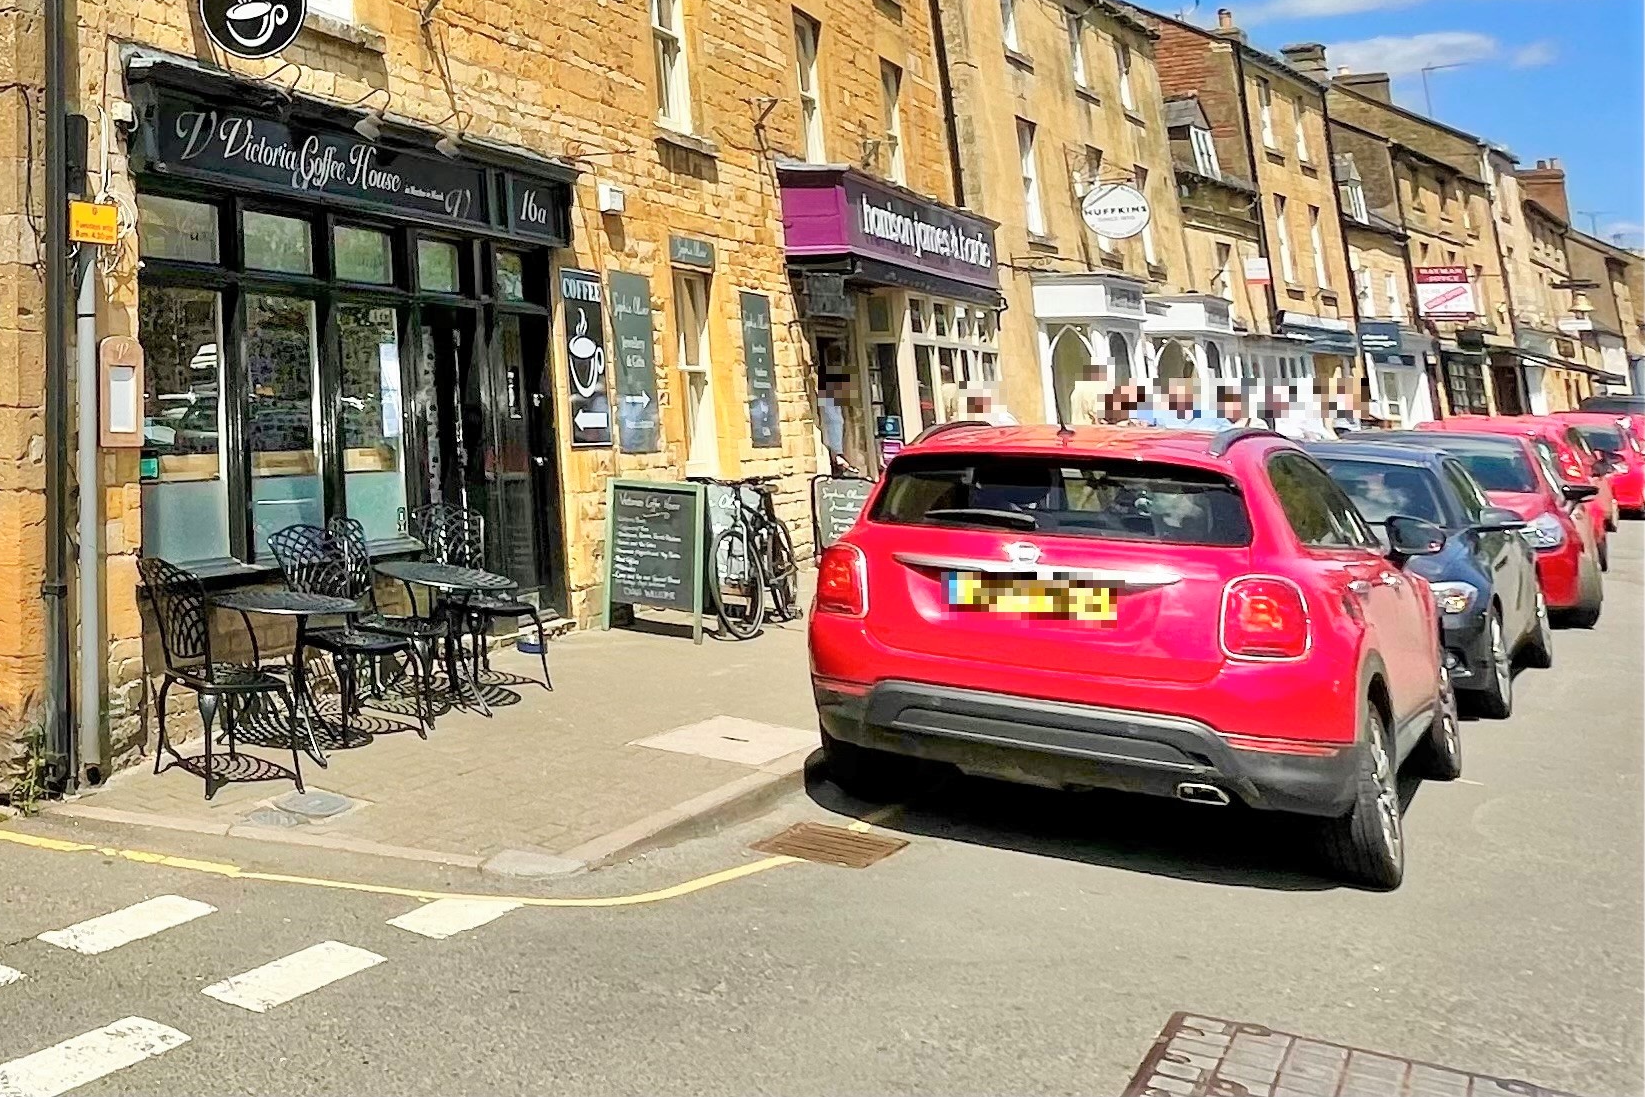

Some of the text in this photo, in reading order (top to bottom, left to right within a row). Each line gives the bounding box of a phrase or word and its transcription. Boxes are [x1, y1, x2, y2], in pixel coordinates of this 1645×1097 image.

[219, 117, 297, 171] Victoria
[300, 135, 346, 188] Coffee
[347, 144, 402, 192] House
[520, 190, 547, 224] 16a
[913, 211, 951, 258] james
[562, 277, 601, 302] COFFEE
